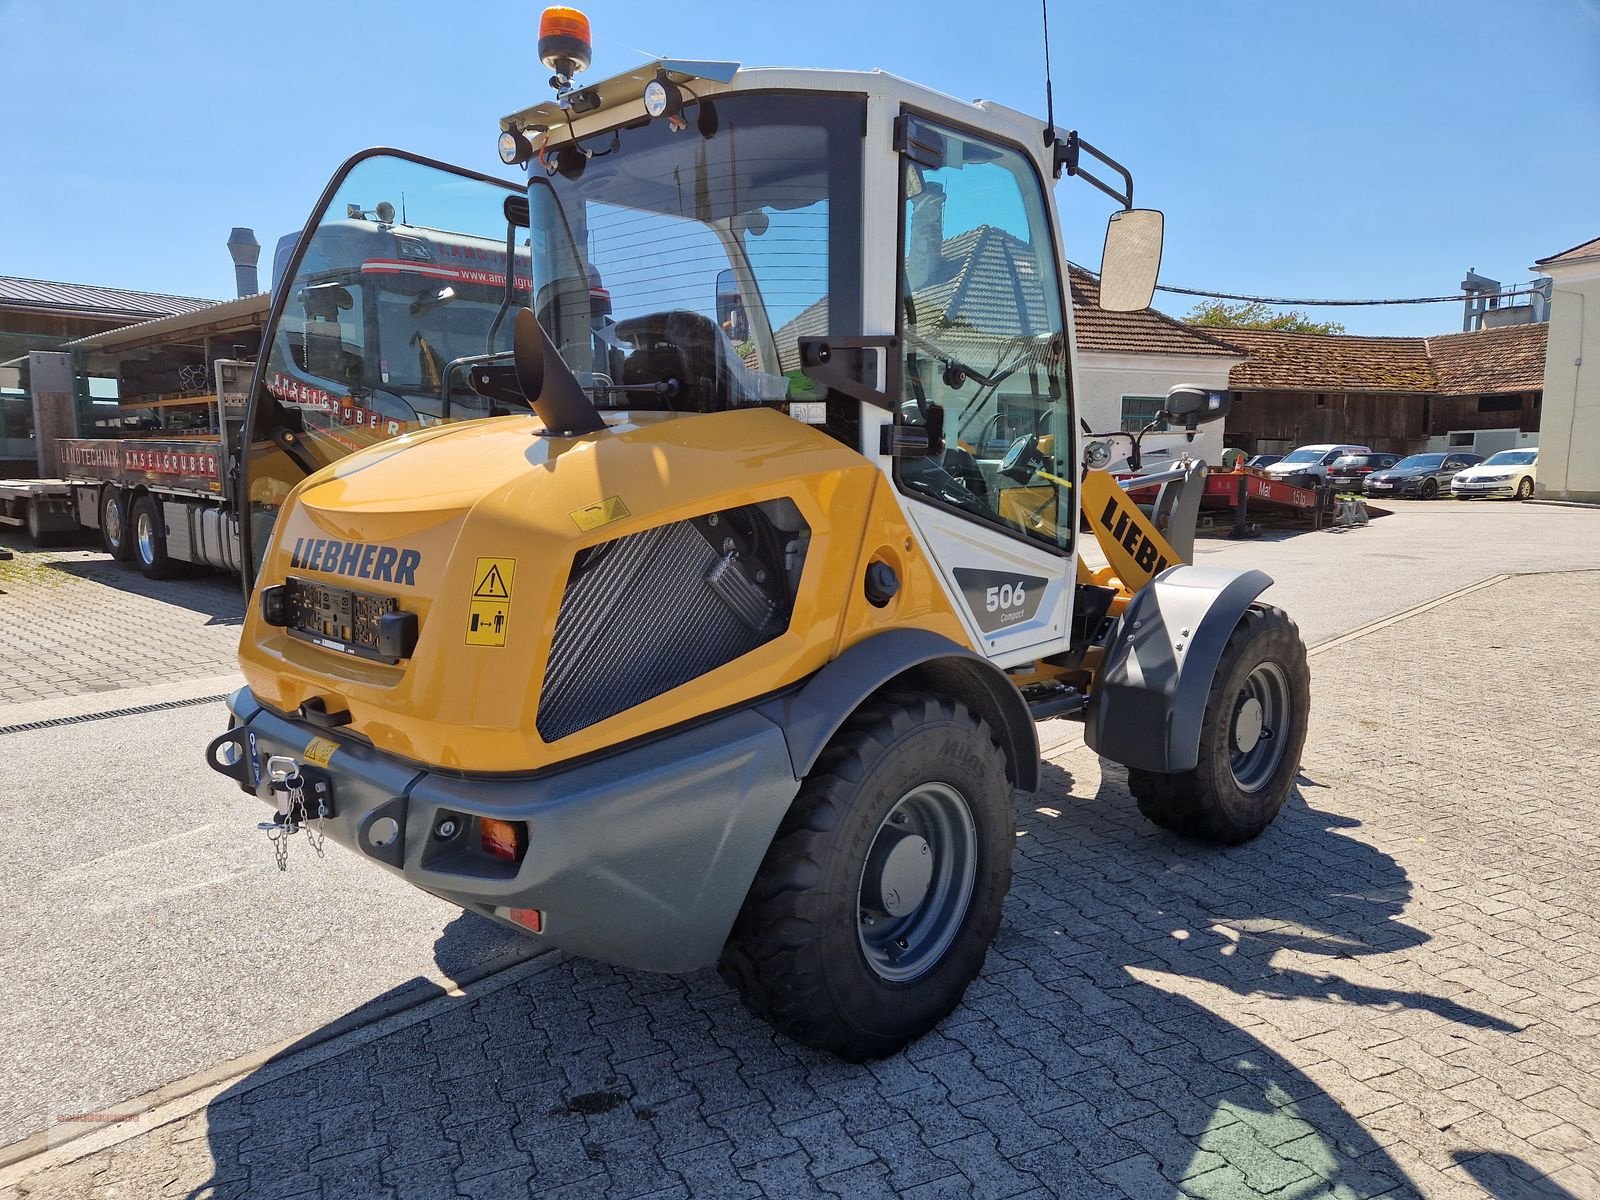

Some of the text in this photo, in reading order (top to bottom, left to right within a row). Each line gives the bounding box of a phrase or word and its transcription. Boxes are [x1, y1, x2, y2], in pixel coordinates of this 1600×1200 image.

[125, 452, 215, 473] AMSELGRUBER
[290, 537, 421, 587] LIEBHERR
[986, 581, 1026, 613] 506
[1000, 609, 1025, 623] Compact
